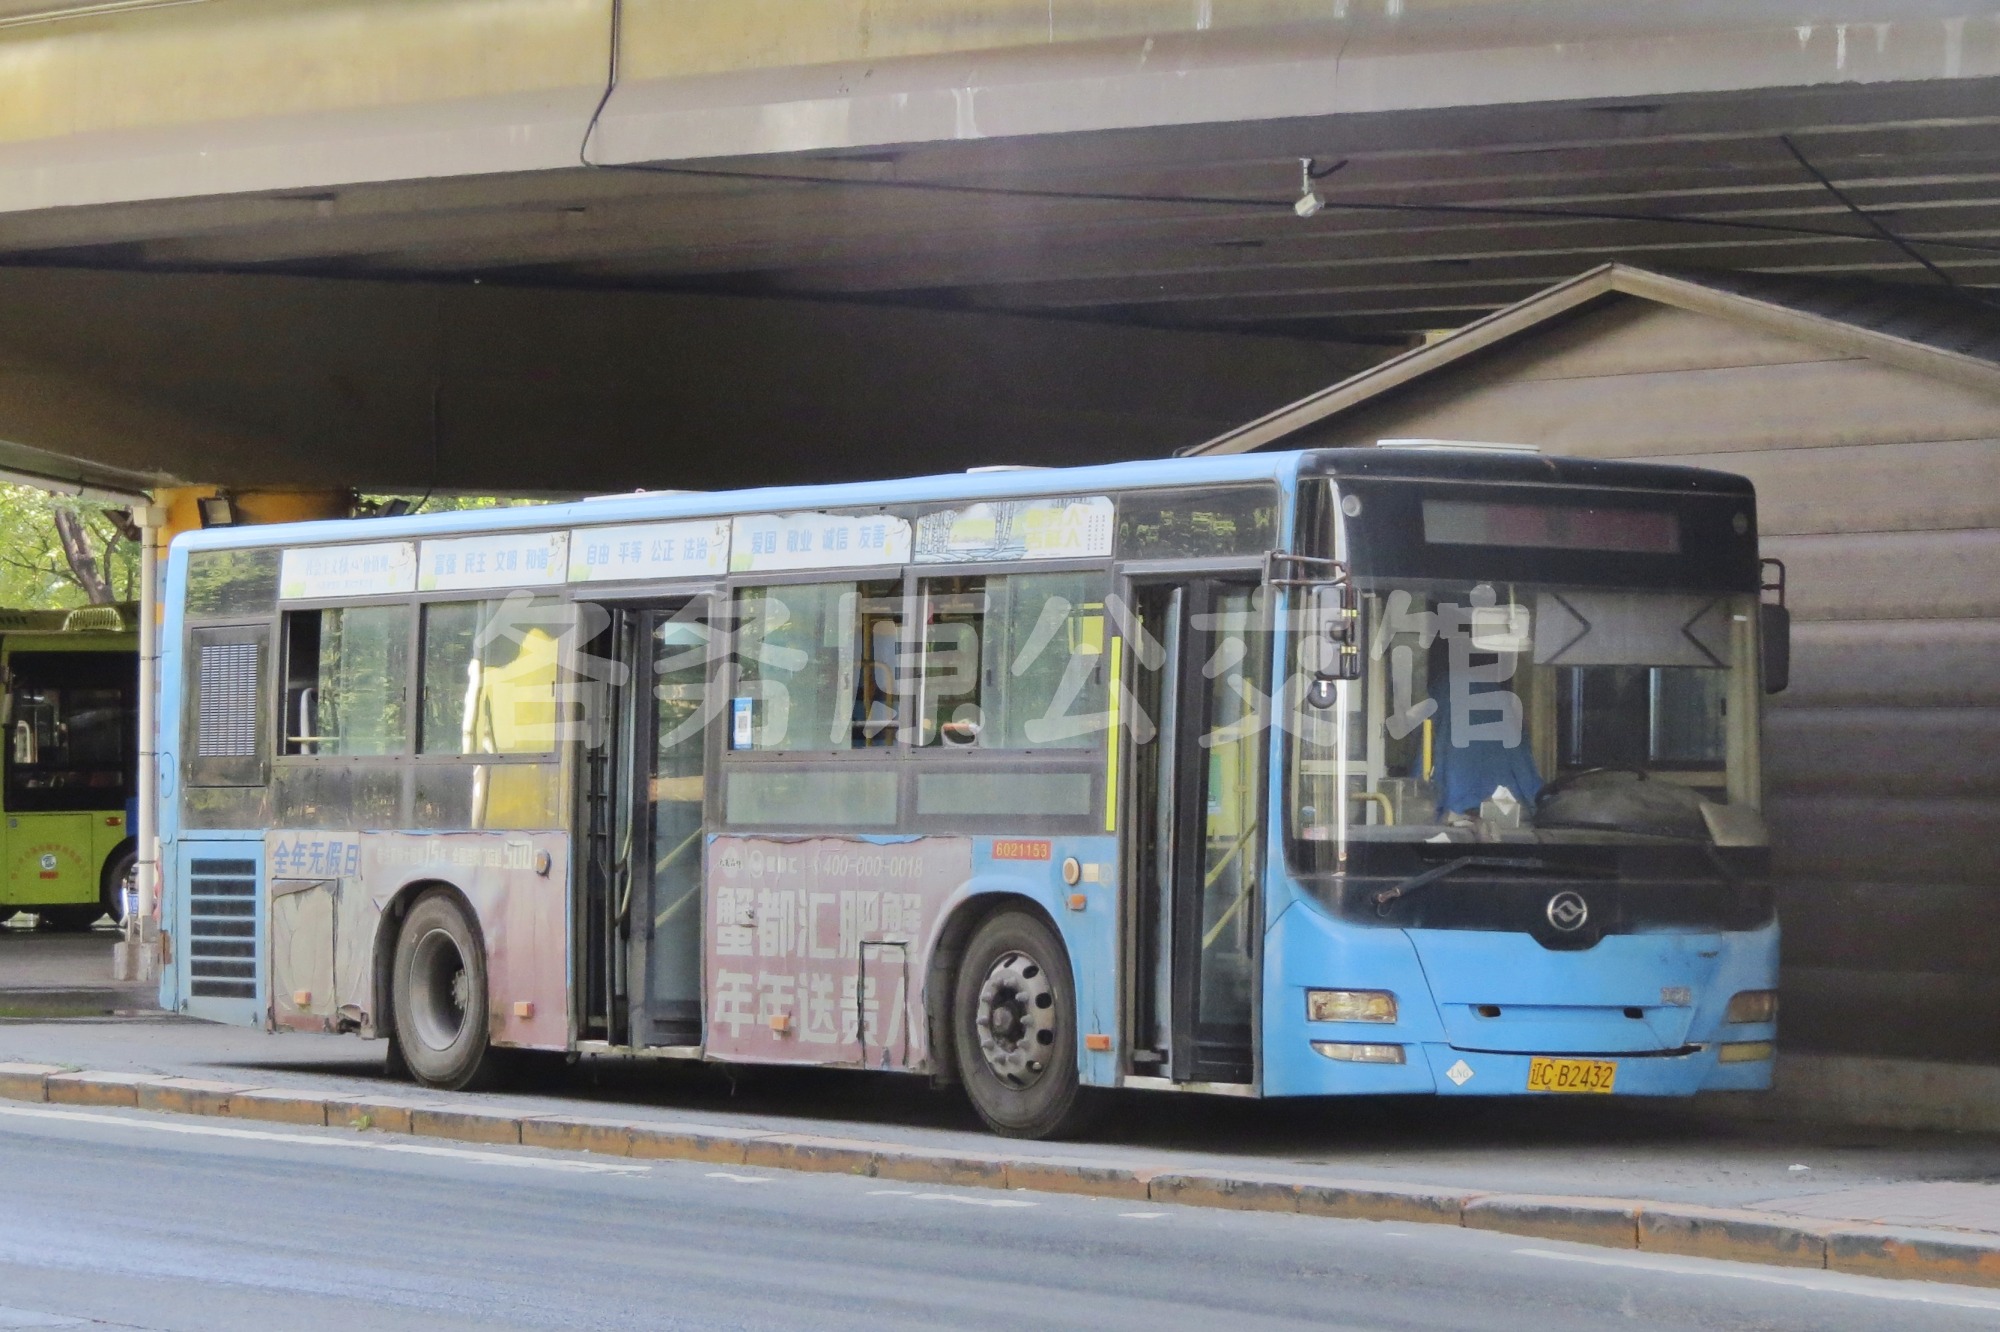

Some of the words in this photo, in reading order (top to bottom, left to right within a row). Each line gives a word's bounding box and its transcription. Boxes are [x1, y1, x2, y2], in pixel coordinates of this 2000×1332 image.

[586, 542, 609, 565] 自由
[618, 540, 643, 563] 平等
[652, 538, 675, 562] 公正
[683, 536, 708, 561] 法治
[751, 531, 776, 555] 爱国
[787, 529, 812, 553] 敬业
[822, 527, 848, 550] 诚信
[859, 524, 887, 549] 友善
[434, 553, 457, 576] 富强
[464, 551, 487, 574] 民主
[496, 549, 518, 572] 文明
[525, 546, 549, 570] 和谐
[273, 840, 361, 877] 全年无假日
[996, 842, 1048, 858] 6021153
[715, 887, 922, 964] 蟹都汇肥蟹
[714, 969, 922, 1049] 年年送贵人
[1451, 1067, 1470, 1079] LNG
